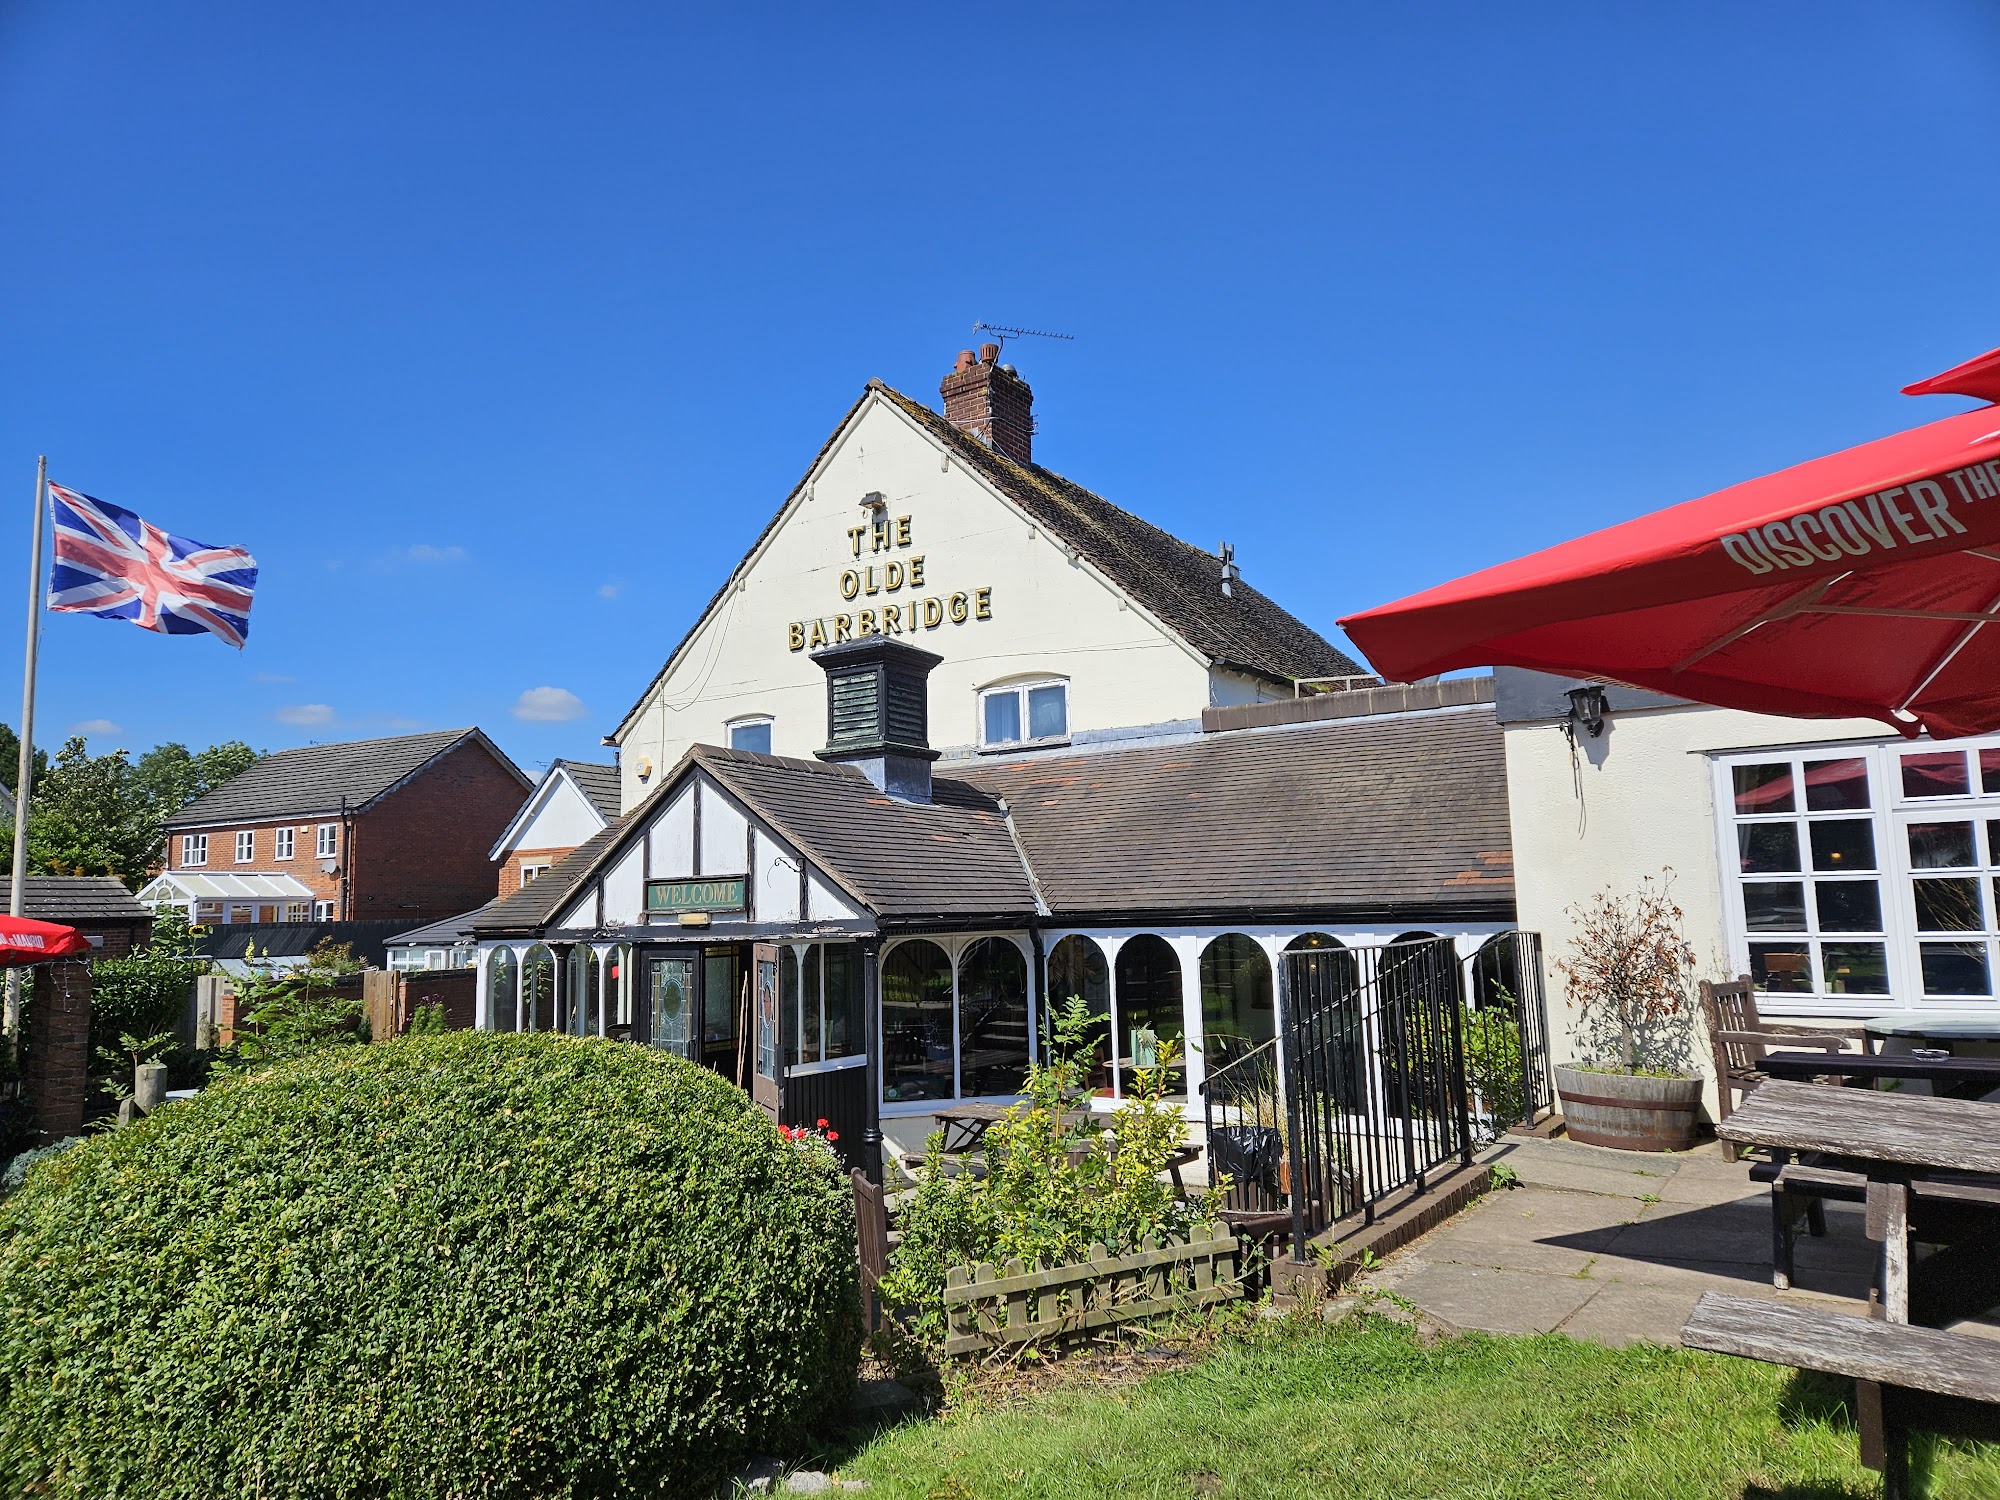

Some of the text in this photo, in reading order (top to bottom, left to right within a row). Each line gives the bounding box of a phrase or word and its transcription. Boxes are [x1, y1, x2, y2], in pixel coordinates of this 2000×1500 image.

[847, 515, 912, 556] THE
[1720, 480, 1968, 575] DISCOVER
[840, 555, 925, 600] OLDE
[788, 587, 992, 651] BARBRIDGE
[655, 882, 738, 905] WELCOME
